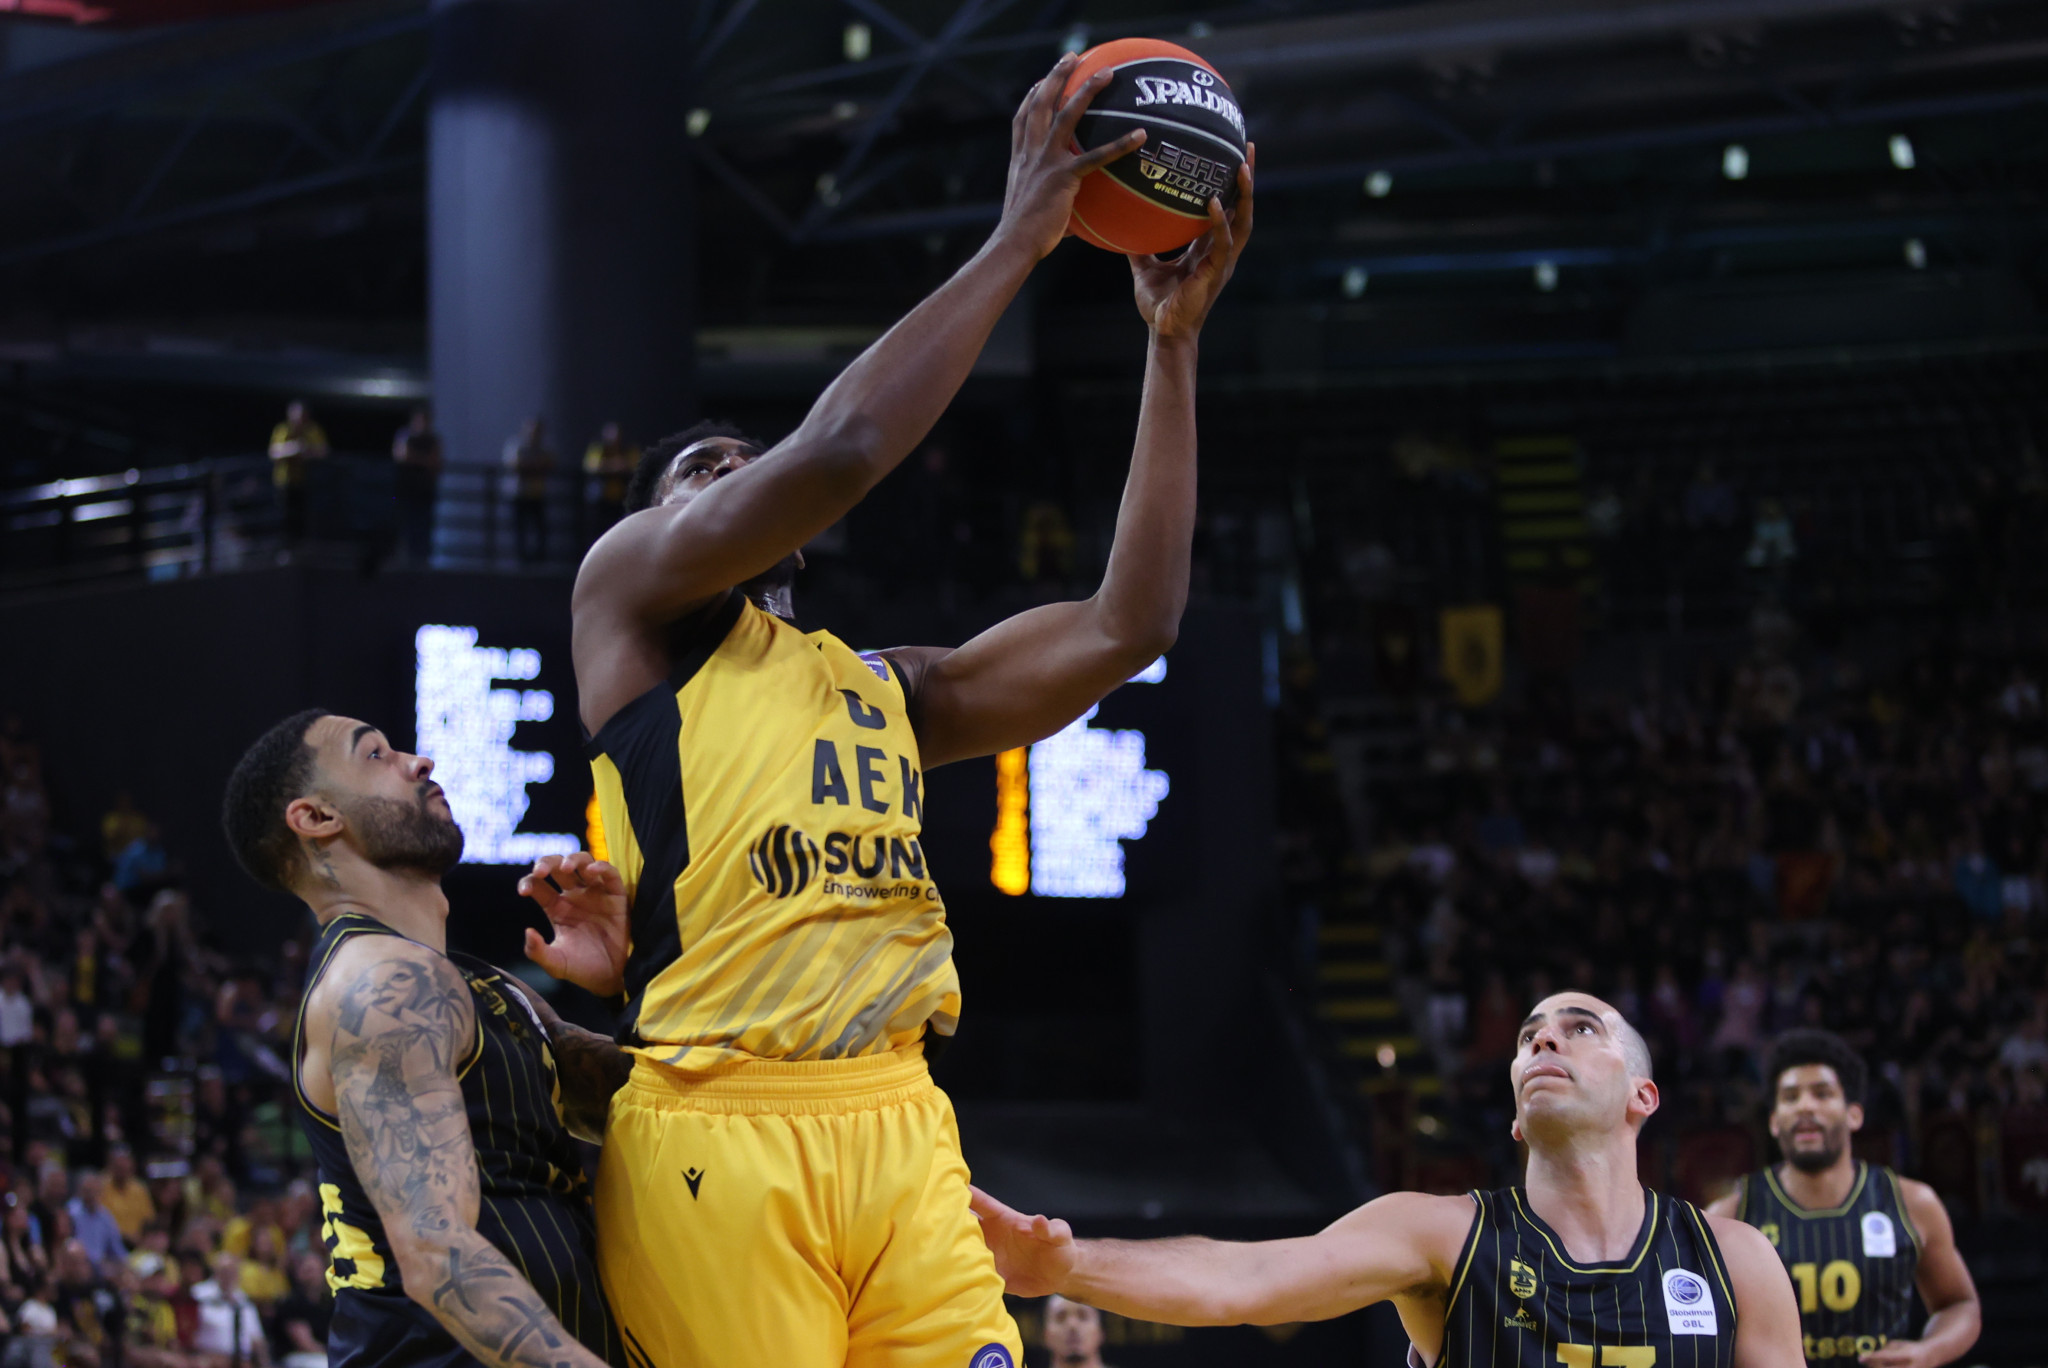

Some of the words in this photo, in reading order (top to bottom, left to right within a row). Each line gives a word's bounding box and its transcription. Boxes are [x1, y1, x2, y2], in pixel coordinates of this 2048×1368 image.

[1154, 182, 1179, 198] OFFICIAL
[1179, 191, 1194, 204] GAME
[812, 738, 924, 826] AEK
[824, 831, 928, 881] SUN
[823, 879, 920, 900] Empowering
[925, 886, 939, 902] C
[1791, 1259, 1862, 1315] 10
[1682, 1320, 1705, 1328] GBL
